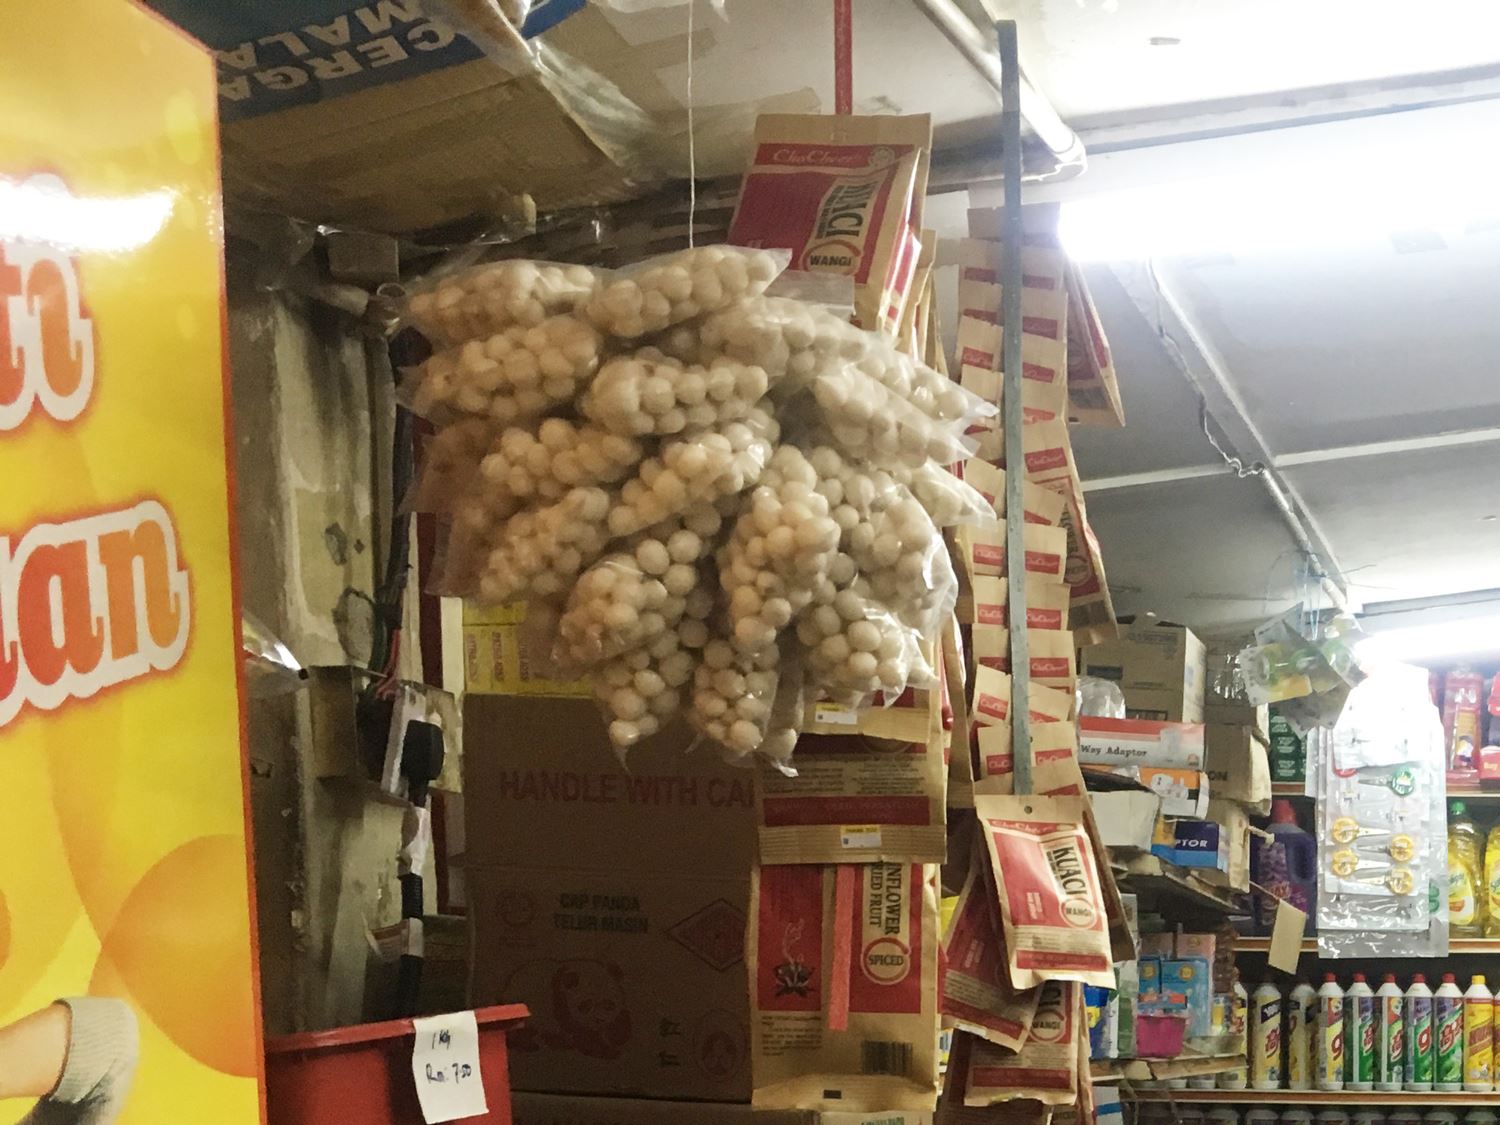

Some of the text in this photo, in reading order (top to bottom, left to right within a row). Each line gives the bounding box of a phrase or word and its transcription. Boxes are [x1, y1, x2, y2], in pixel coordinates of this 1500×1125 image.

[1106, 745, 1148, 758] Adaptor
[500, 770, 618, 803] HANDLE
[626, 772, 699, 806] WITH
[706, 774, 755, 808] CA
[1052, 845, 1088, 896] KUACI
[869, 891, 883, 927] FRUIT
[868, 954, 905, 967] SPICED
